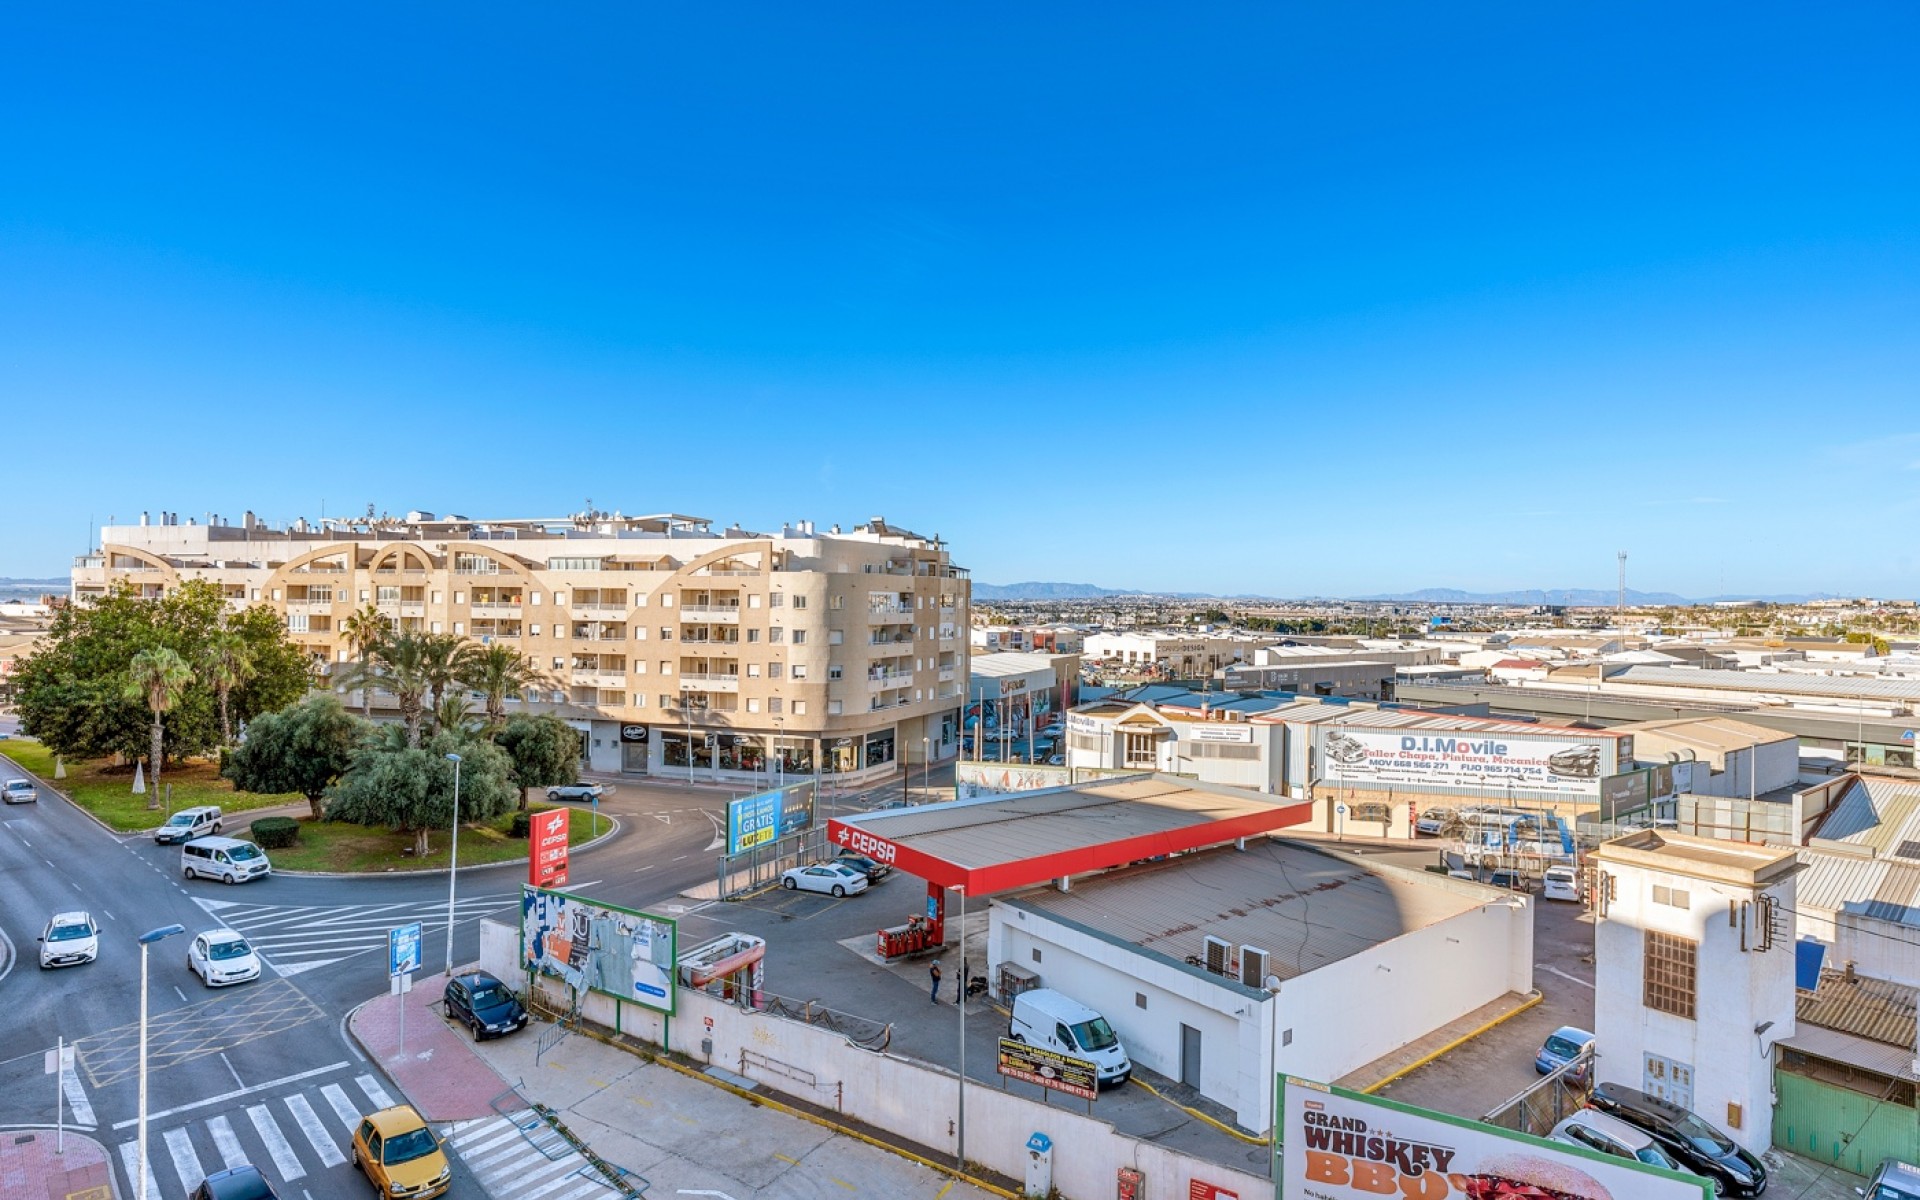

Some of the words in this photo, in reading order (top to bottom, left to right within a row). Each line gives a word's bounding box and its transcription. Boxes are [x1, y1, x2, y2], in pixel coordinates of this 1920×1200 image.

[1401, 736, 1508, 755] D.I.Movile
[1362, 748, 1396, 758] Taller
[1398, 751, 1439, 761] Chapa,
[1442, 753, 1489, 763] Pintura,
[1414, 761, 1431, 769] 566
[1433, 762, 1449, 770] 271
[1461, 763, 1482, 771] FIJO
[1484, 765, 1503, 773] 965
[743, 813, 774, 832] GRATIS
[542, 833, 567, 847] CEPSA
[851, 831, 896, 863] CEPSA
[1304, 1111, 1367, 1133] GRAND
[1304, 1125, 1456, 1176] WHISKEY
[1305, 1150, 1449, 1200] BBQ
